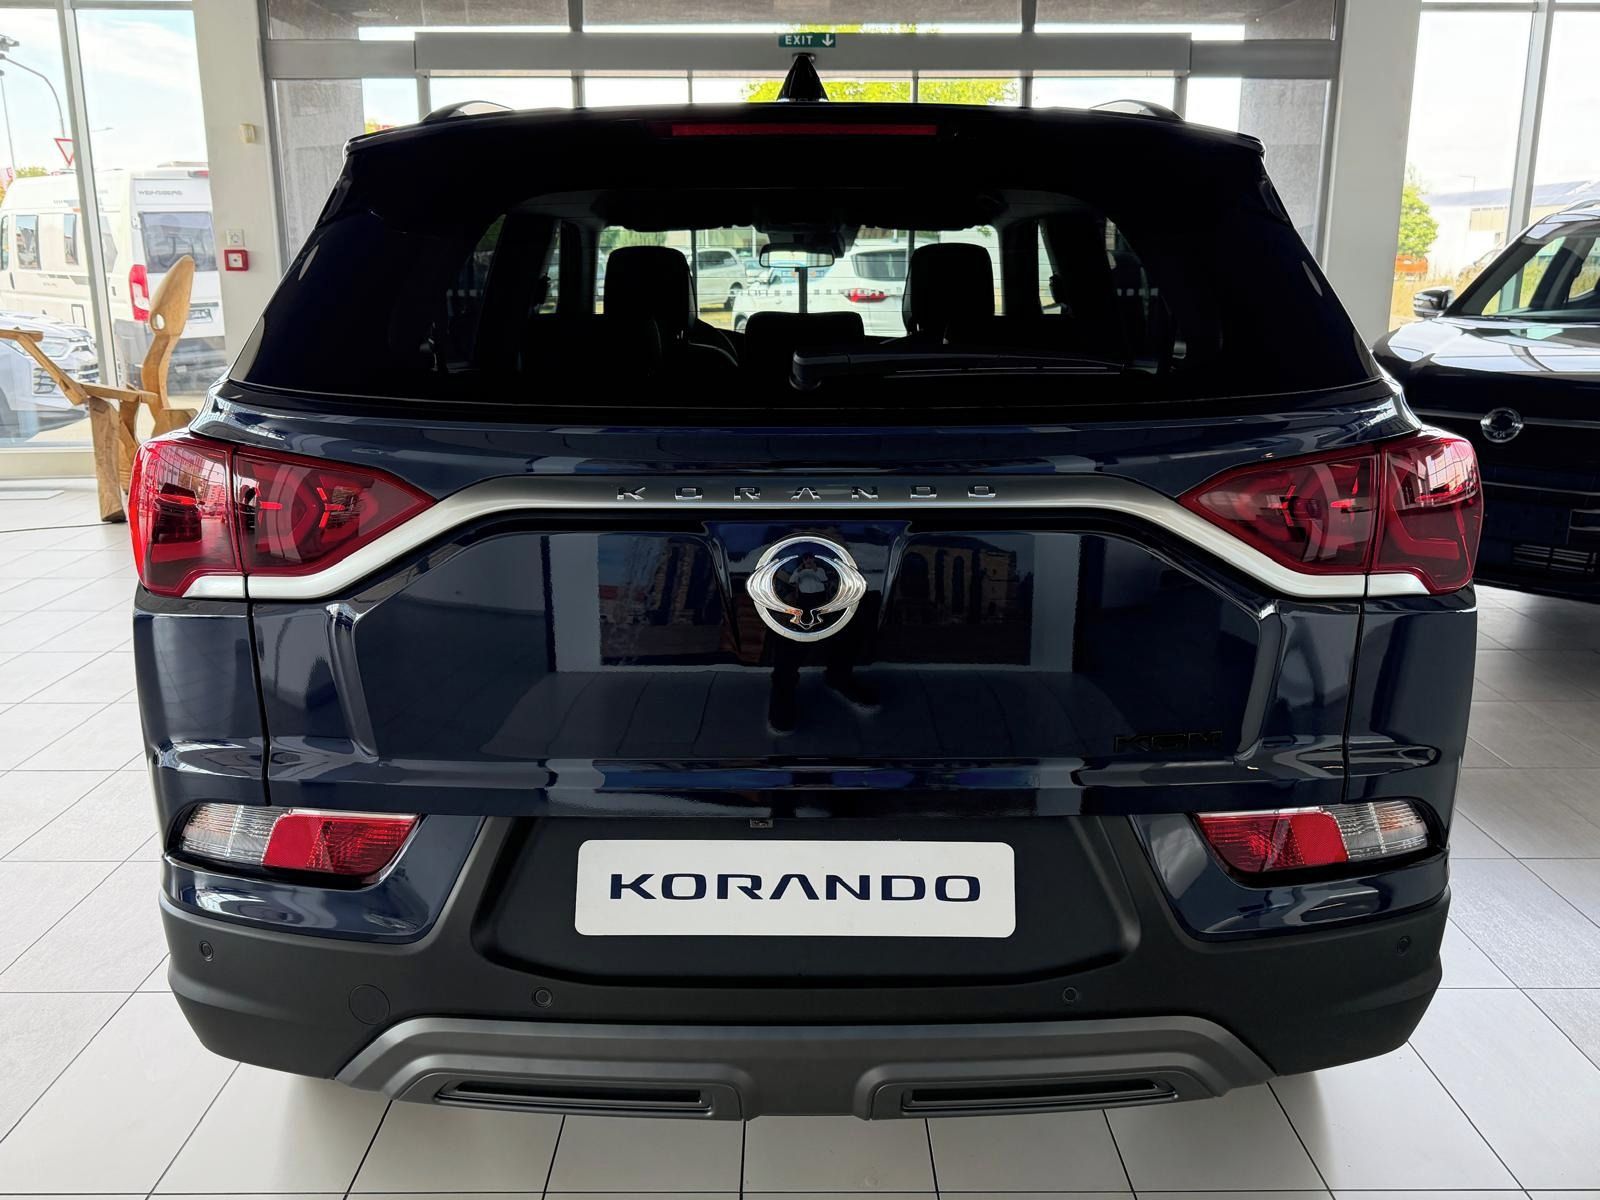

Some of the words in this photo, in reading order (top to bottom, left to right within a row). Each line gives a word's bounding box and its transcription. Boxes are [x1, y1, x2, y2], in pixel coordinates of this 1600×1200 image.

[785, 35, 813, 45] EXIT
[617, 485, 996, 500] KORANDO
[609, 873, 981, 902] KORANDO
